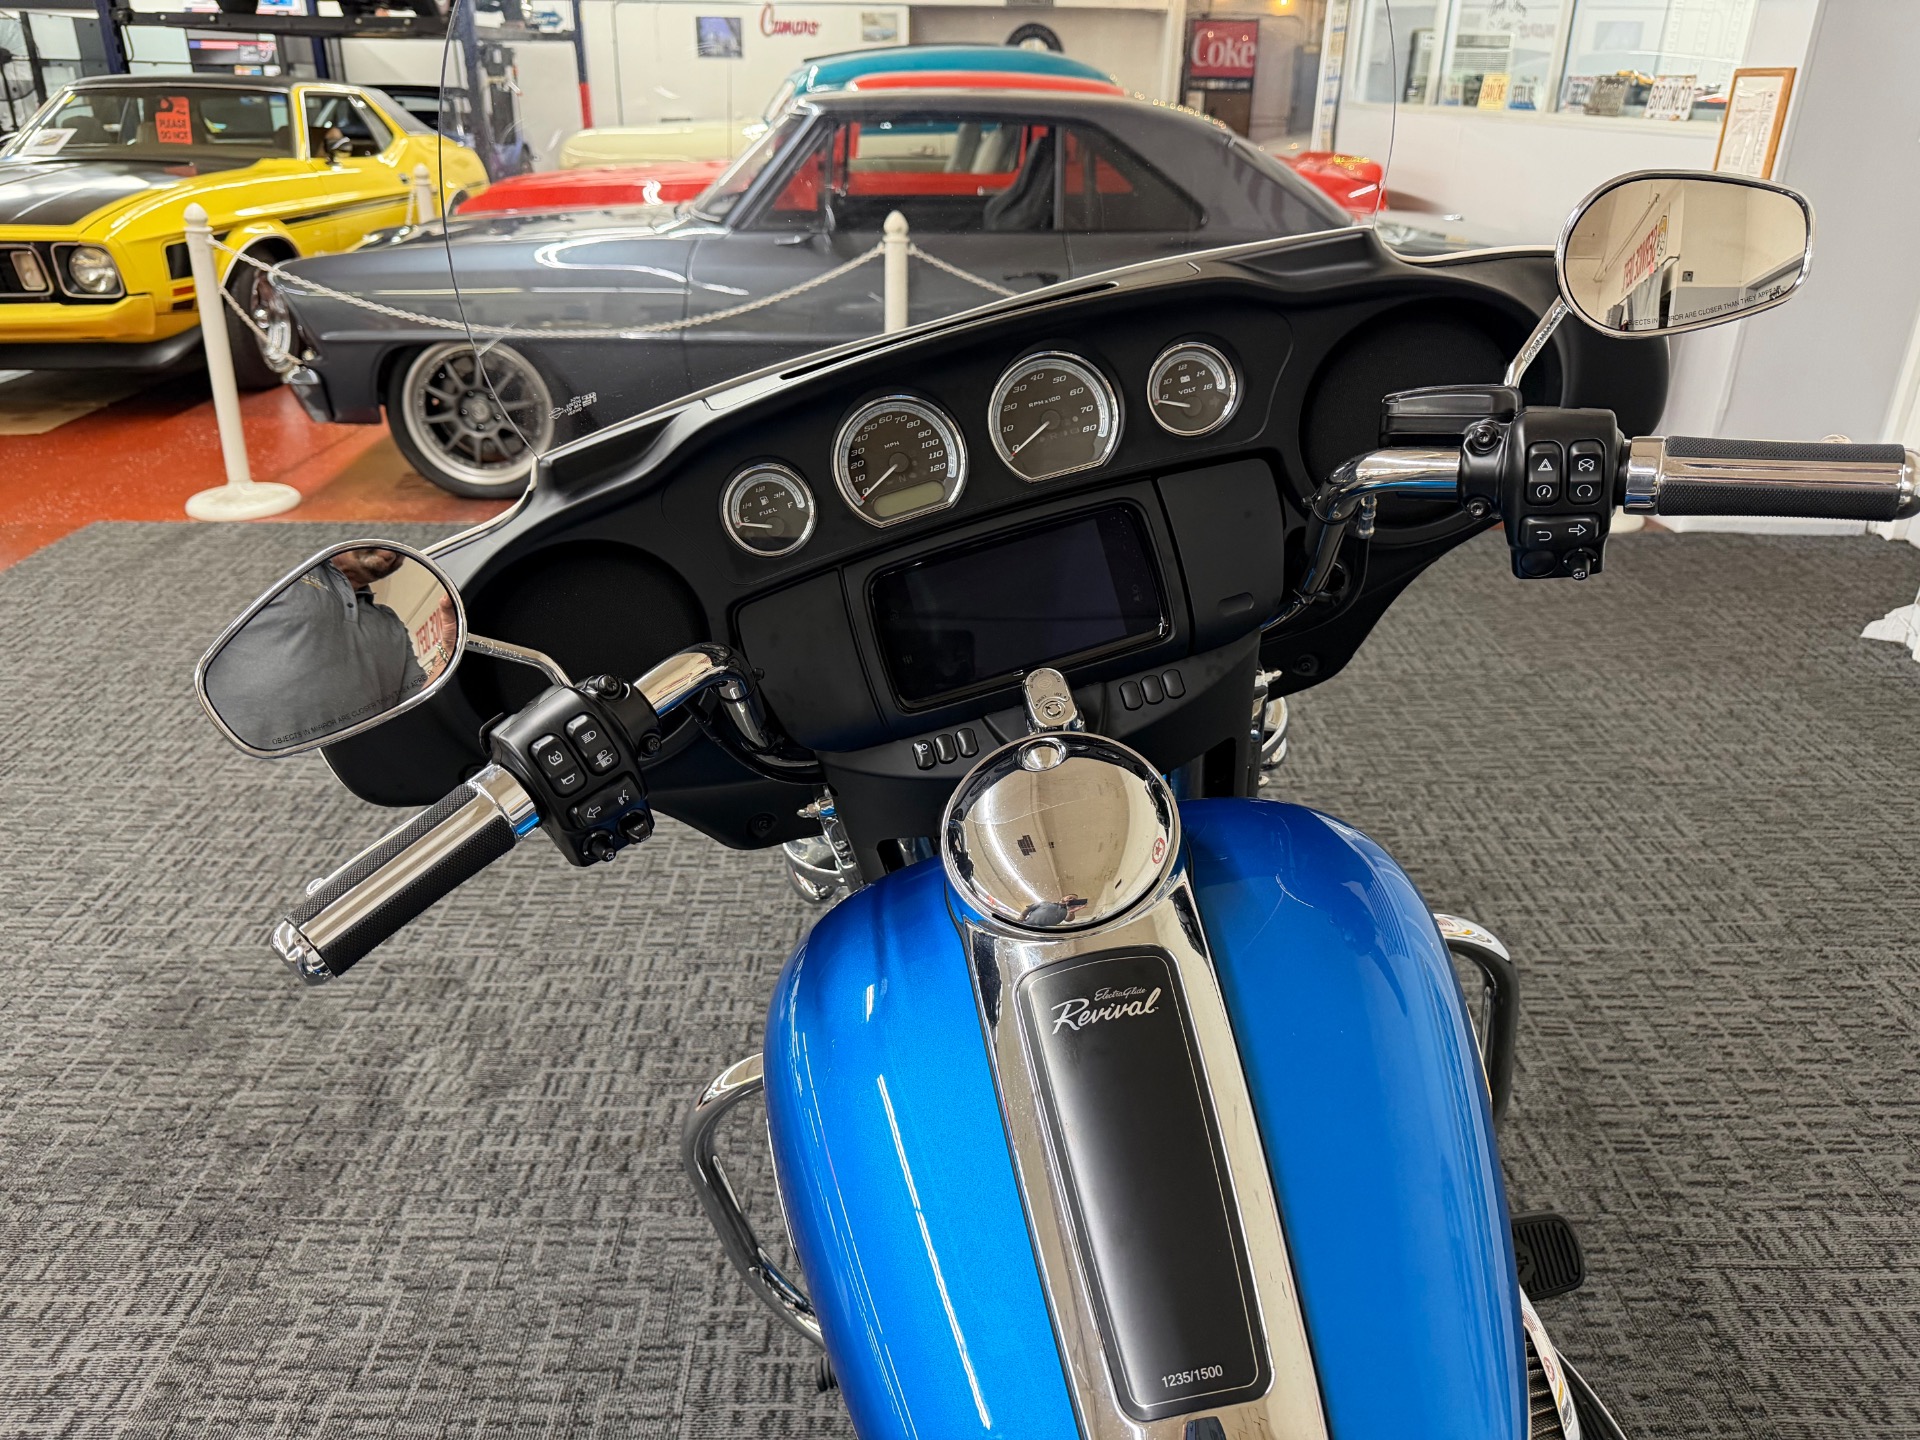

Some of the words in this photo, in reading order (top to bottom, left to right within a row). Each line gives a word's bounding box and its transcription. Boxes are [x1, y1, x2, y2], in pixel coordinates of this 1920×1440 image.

[1192, 28, 1256, 68] Coke
[1684, 311, 1698, 319] ARE
[1698, 304, 1723, 316] CLOSER
[1723, 299, 1740, 309] THAN
[1740, 295, 1757, 304] THEY
[1030, 372, 1045, 381] 40
[1052, 375, 1067, 384] 50
[1163, 378, 1173, 386] 10
[1012, 384, 1028, 393] 30
[1069, 387, 1084, 396] 60
[1178, 386, 1197, 395] VOLT
[1003, 402, 1018, 412] 20
[1080, 404, 1094, 414] 70
[878, 414, 893, 424] 60
[894, 414, 908, 424] 70
[906, 419, 921, 429] 80
[863, 423, 878, 433] 50
[1002, 424, 1014, 433] 10
[1082, 424, 1097, 433] 80
[854, 433, 869, 443] 40
[917, 429, 932, 439] 90
[883, 440, 900, 450] MPH
[921, 438, 939, 449] 100
[850, 447, 865, 457] 30
[928, 450, 944, 460] 110
[850, 460, 865, 470] 20
[929, 462, 946, 473] 120
[854, 473, 866, 483] 10
[787, 501, 793, 509] F
[758, 507, 778, 516] FUEL
[272, 731, 302, 745] OBJECTS
[311, 719, 337, 733] MIRROR
[338, 713, 351, 723] ARE
[1050, 987, 1162, 1035] Revival
[1161, 1364, 1223, 1388] 1235/1500
